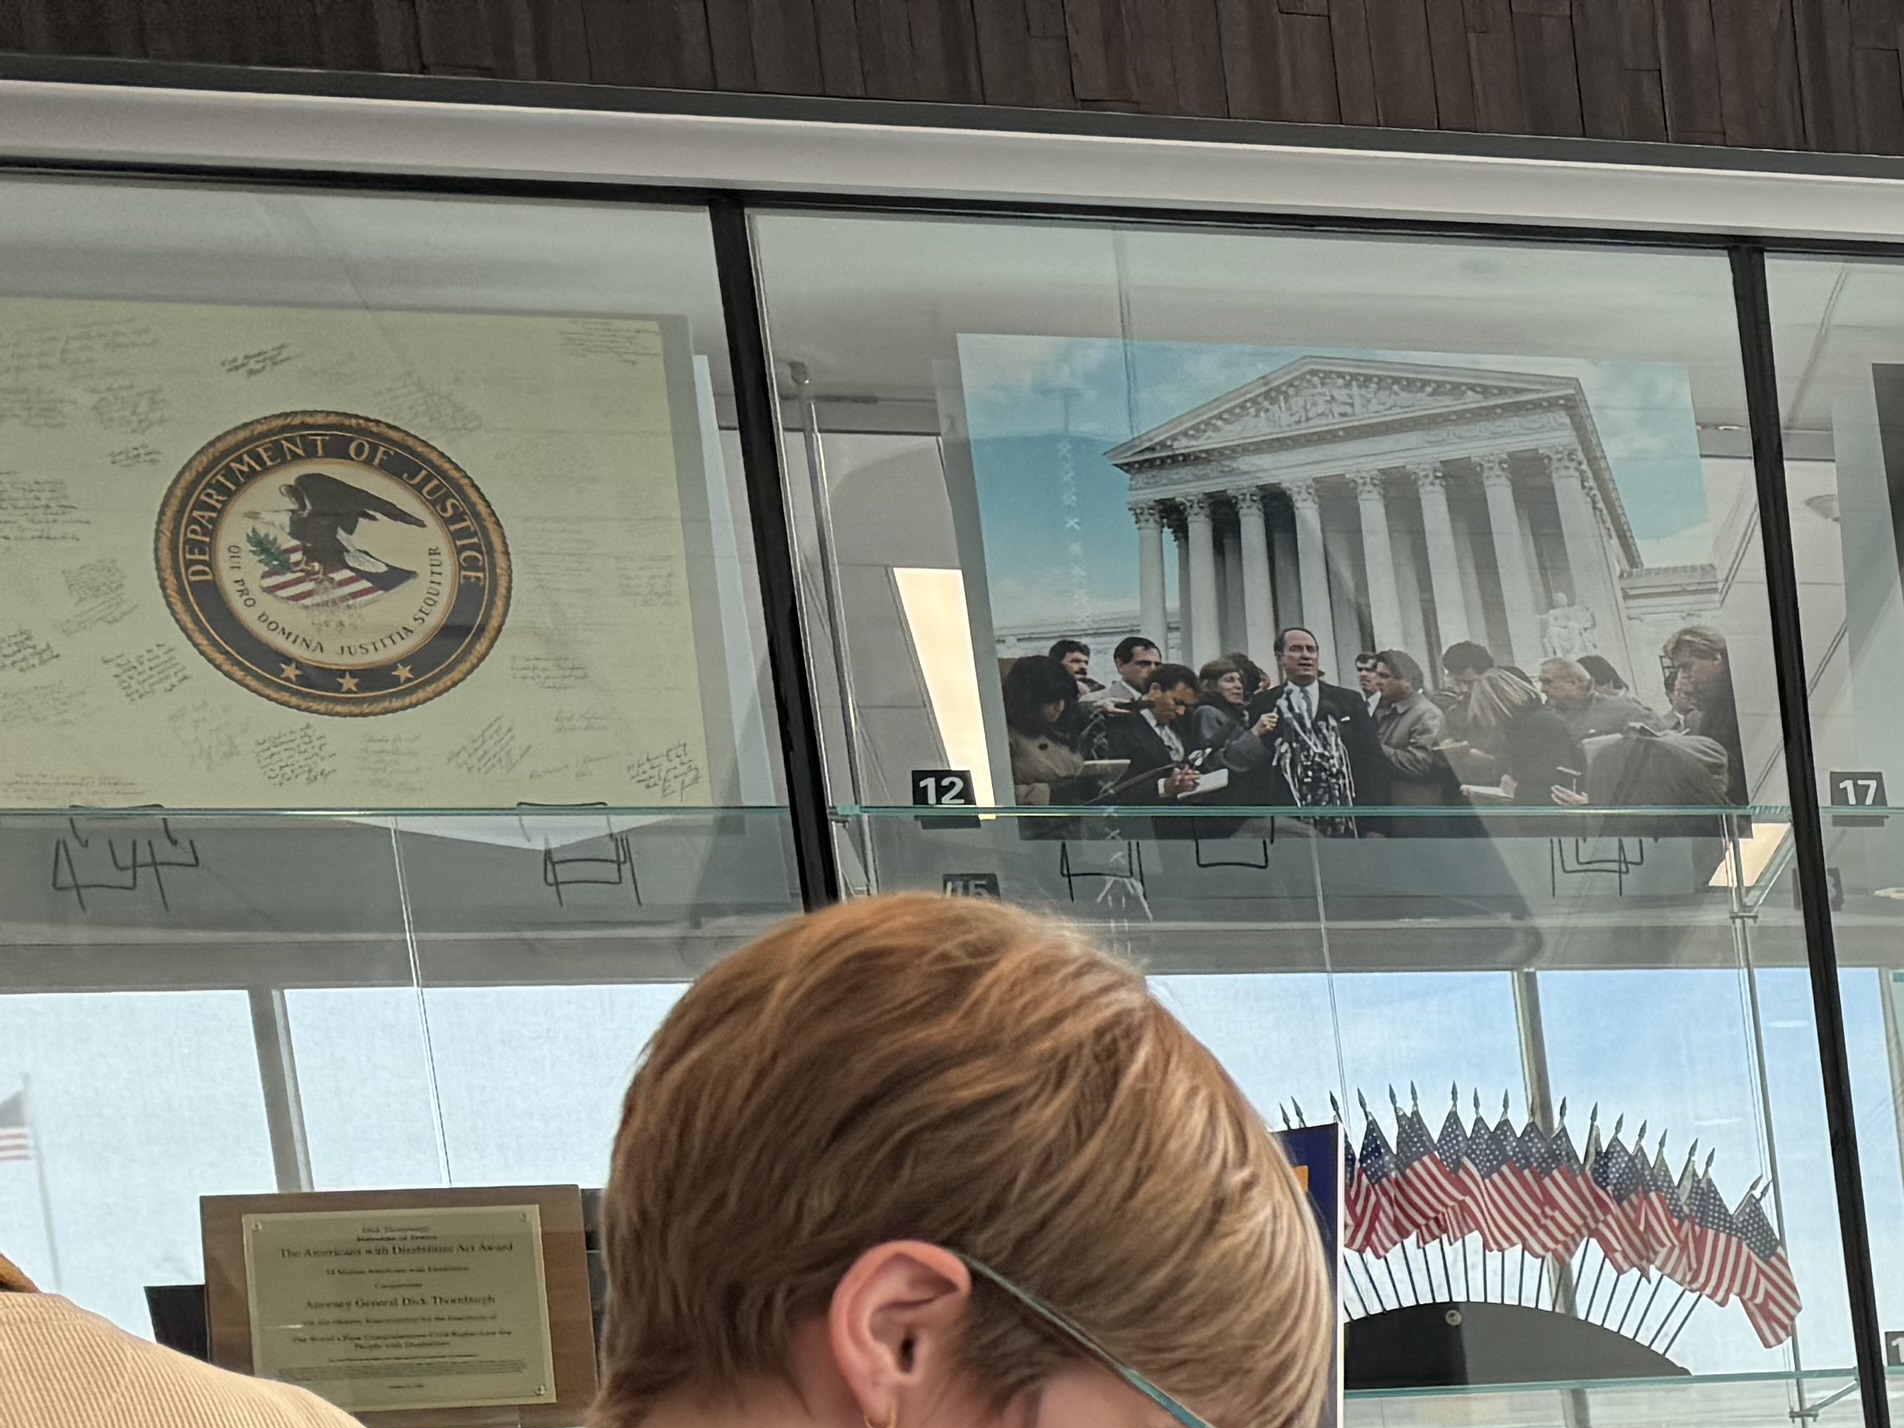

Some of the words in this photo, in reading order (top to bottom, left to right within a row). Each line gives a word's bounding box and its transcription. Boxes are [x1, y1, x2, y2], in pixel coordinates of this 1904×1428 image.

[188, 436, 329, 582] DEPARTMENT
[349, 440, 394, 467] OF
[403, 469, 485, 587] JUSTICE
[227, 544, 241, 573] QUI
[234, 579, 257, 609] PRO
[257, 611, 324, 654] DOMINA
[336, 625, 414, 656] JUSTITIA
[412, 546, 442, 626] SEQUITUR
[919, 776, 965, 805] 12
[1839, 779, 1877, 806] 17
